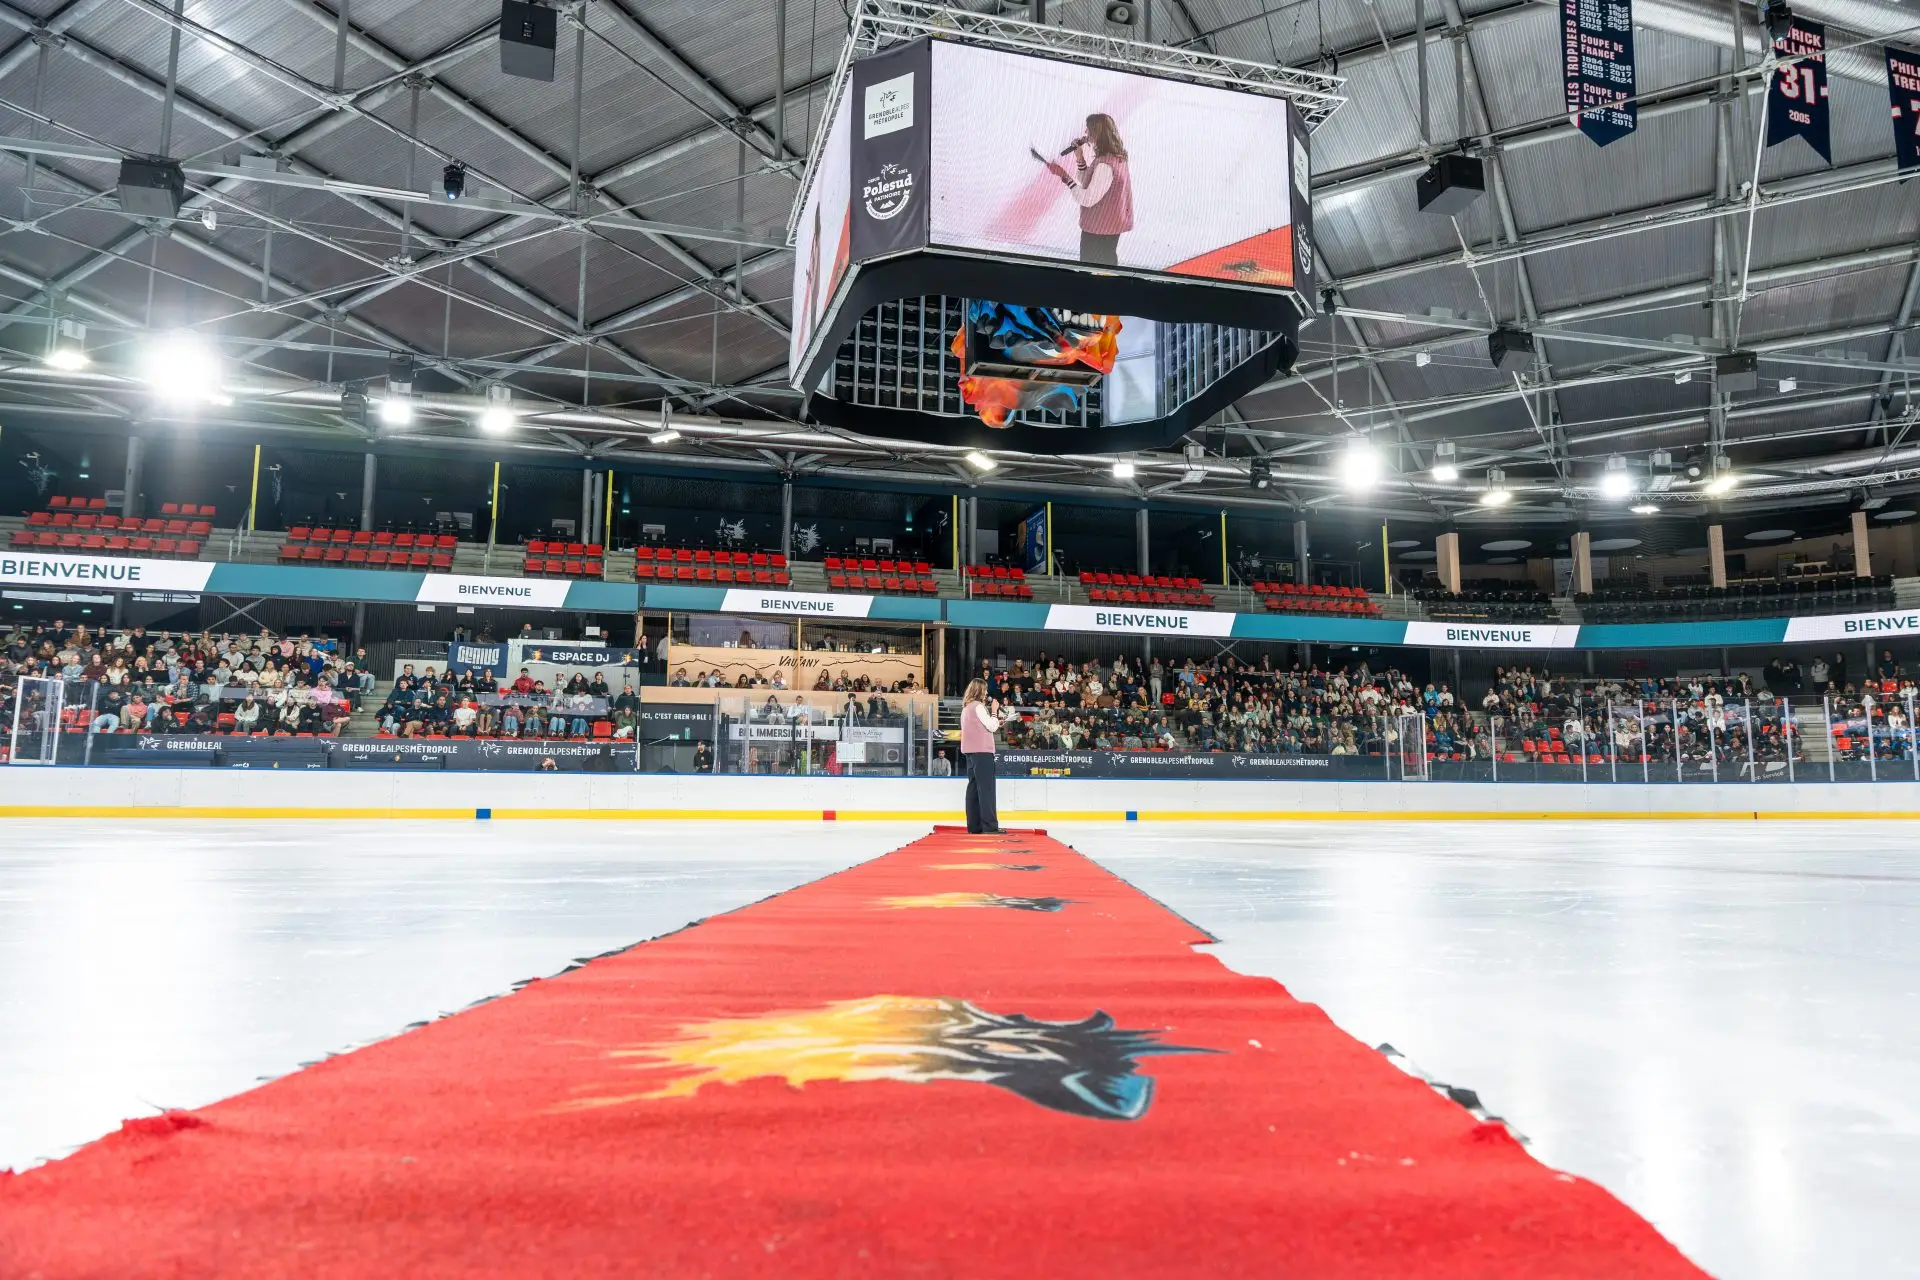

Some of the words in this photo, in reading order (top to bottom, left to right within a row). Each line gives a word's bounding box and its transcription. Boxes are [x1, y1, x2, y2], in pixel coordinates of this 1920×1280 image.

[1580, 21, 1602, 32] 2025
[1566, 19, 1579, 77] TROPHEES
[1580, 33, 1610, 49] COUPE
[1613, 41, 1624, 53] DE
[1580, 44, 1615, 61] FRANCE
[1610, 74, 1633, 84] 2024
[1779, 64, 1816, 105] 31
[1568, 82, 1580, 103] LES
[1583, 82, 1612, 98] COUPE
[1583, 94, 1594, 105] LA
[1788, 109, 1811, 125] 2005
[863, 173, 913, 199] Polesud
[873, 190, 901, 202] PATINOIRE
[1, 559, 142, 581] BIENVENUE
[458, 584, 532, 597] BIENVENUE
[760, 598, 834, 612] BIENVENUE
[1096, 612, 1188, 629] BIENVENUE
[1446, 628, 1532, 643] BIENVENUE
[552, 651, 594, 662] ESPACE
[595, 653, 610, 663] DJ
[757, 728, 802, 738] IMMERSIN
